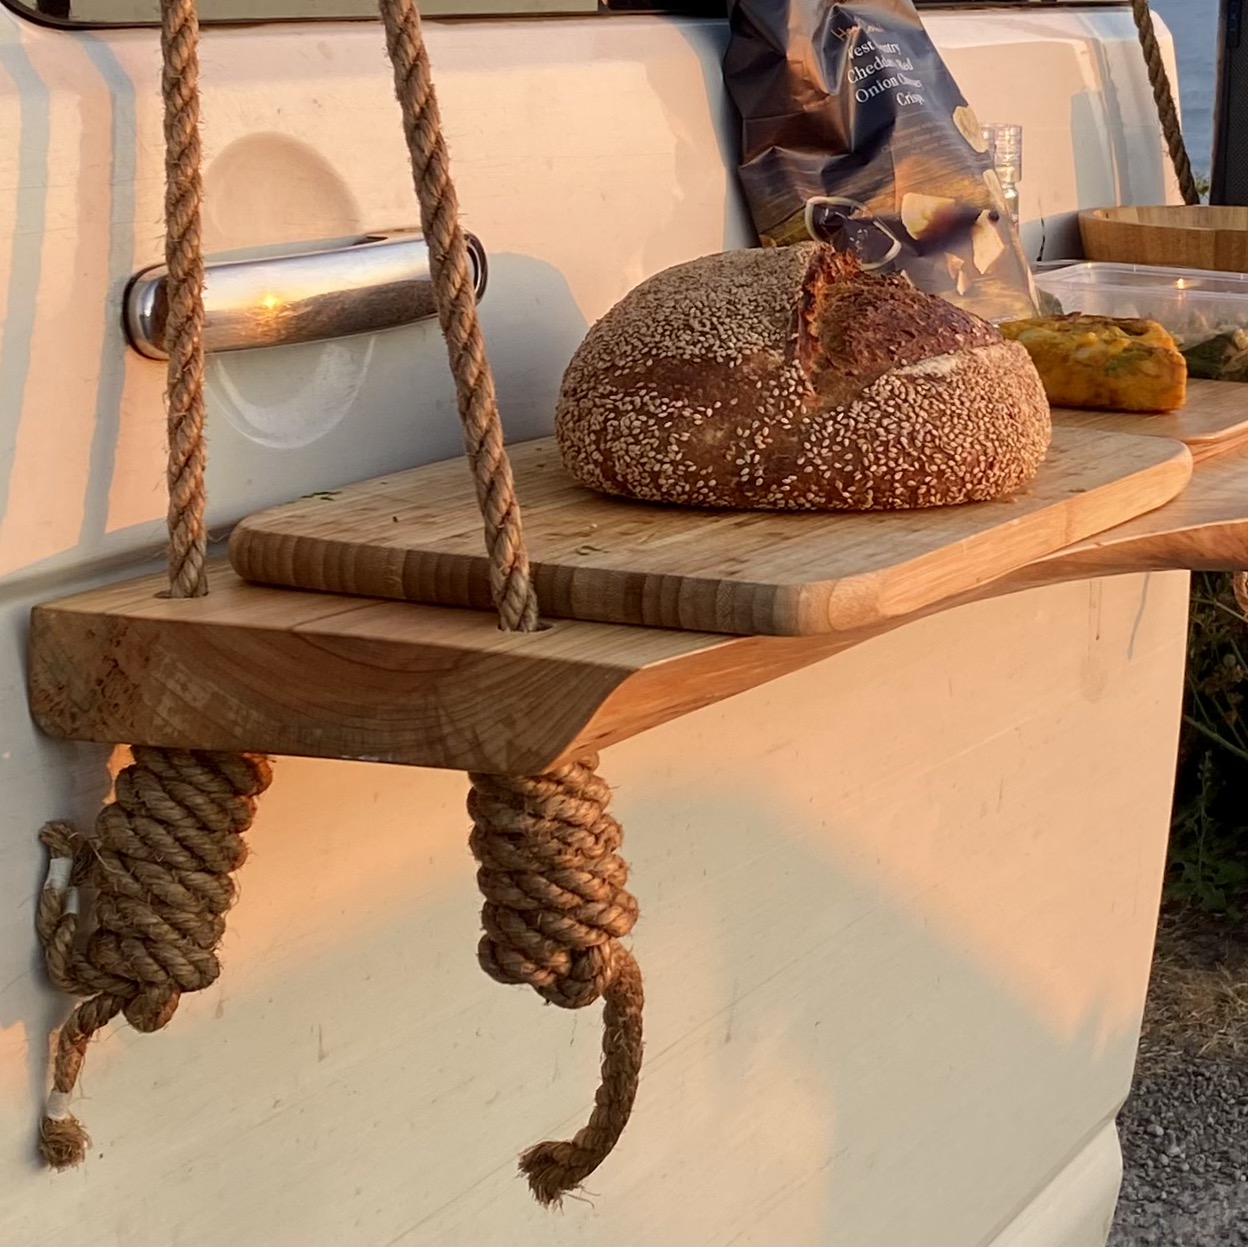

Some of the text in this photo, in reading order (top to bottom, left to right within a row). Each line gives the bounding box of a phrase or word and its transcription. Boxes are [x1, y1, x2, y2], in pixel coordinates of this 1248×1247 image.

[847, 56, 896, 84] Chedda
[855, 75, 899, 103] Onion
[896, 93, 924, 106] Crisp
